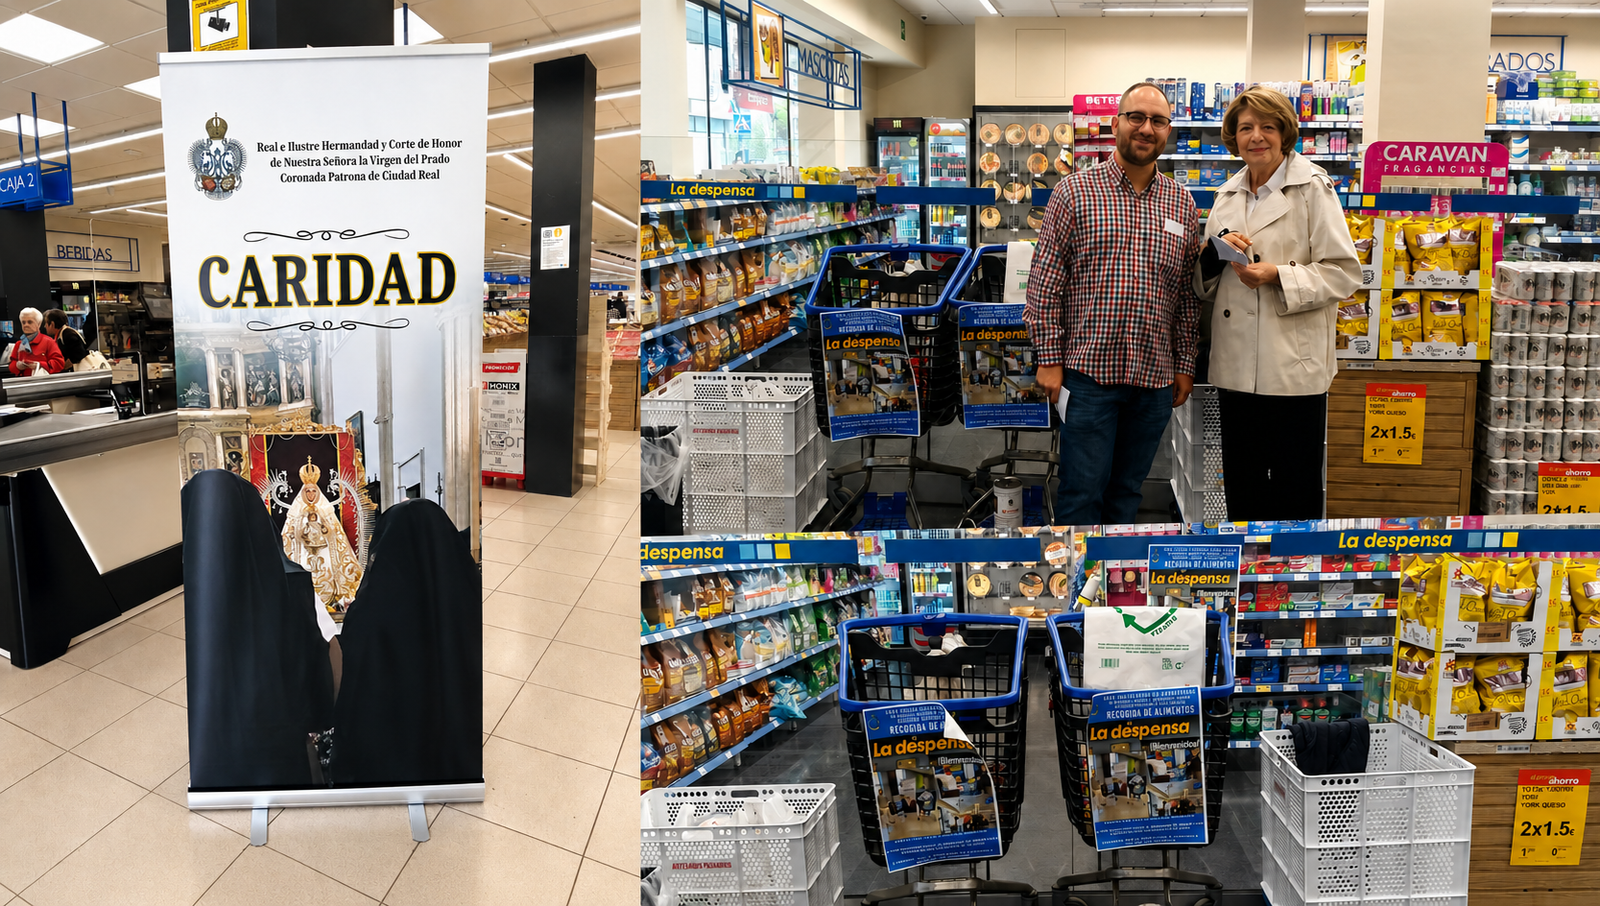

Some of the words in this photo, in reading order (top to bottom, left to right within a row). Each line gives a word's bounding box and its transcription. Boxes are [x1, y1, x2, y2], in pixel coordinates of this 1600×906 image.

[798, 46, 850, 87] MASCOTAS
[257, 142, 278, 153] Real
[288, 141, 320, 152] Ilustre
[322, 140, 379, 151] Hermandad
[381, 143, 387, 152] y
[389, 139, 415, 150] Corte
[417, 138, 430, 149] de
[431, 138, 463, 149] Honor
[1383, 144, 1488, 162] CARAVAN
[270, 157, 282, 168] de
[284, 157, 321, 168] Nuestra
[323, 155, 357, 167] Señora
[358, 155, 369, 166] la
[370, 155, 402, 168] Virgen
[403, 154, 420, 165] del
[421, 154, 450, 165] Prado
[1384, 164, 1485, 173] FRAGANCIAS
[0, 175, 25, 193] CAJA
[27, 172, 34, 187] 2
[280, 172, 326, 183] Coronada
[328, 171, 366, 182] Patrona
[368, 171, 380, 181] de
[382, 170, 416, 181] Ciudad
[418, 169, 440, 180] Real
[670, 183, 686, 196] La
[689, 183, 756, 199] despensa
[57, 244, 113, 261] BEBIDAS
[198, 251, 457, 309] CARIDAD
[961, 330, 975, 341] La
[826, 339, 840, 350] La
[842, 337, 900, 350] despensa
[1370, 426, 1416, 439] 2x1.5€
[1338, 532, 1360, 549] La
[1363, 531, 1452, 551] despensa
[640, 544, 724, 563] despensa
[1150, 572, 1165, 584] La
[1167, 571, 1230, 587] despensa
[1144, 707, 1152, 716] DE
[1154, 705, 1195, 715] ALIMENTOS
[1090, 727, 1108, 741] La
[1110, 722, 1190, 740] despensa
[873, 743, 892, 758] La
[1549, 777, 1579, 785] ahorro
[1520, 821, 1575, 836] 2x1.5€
